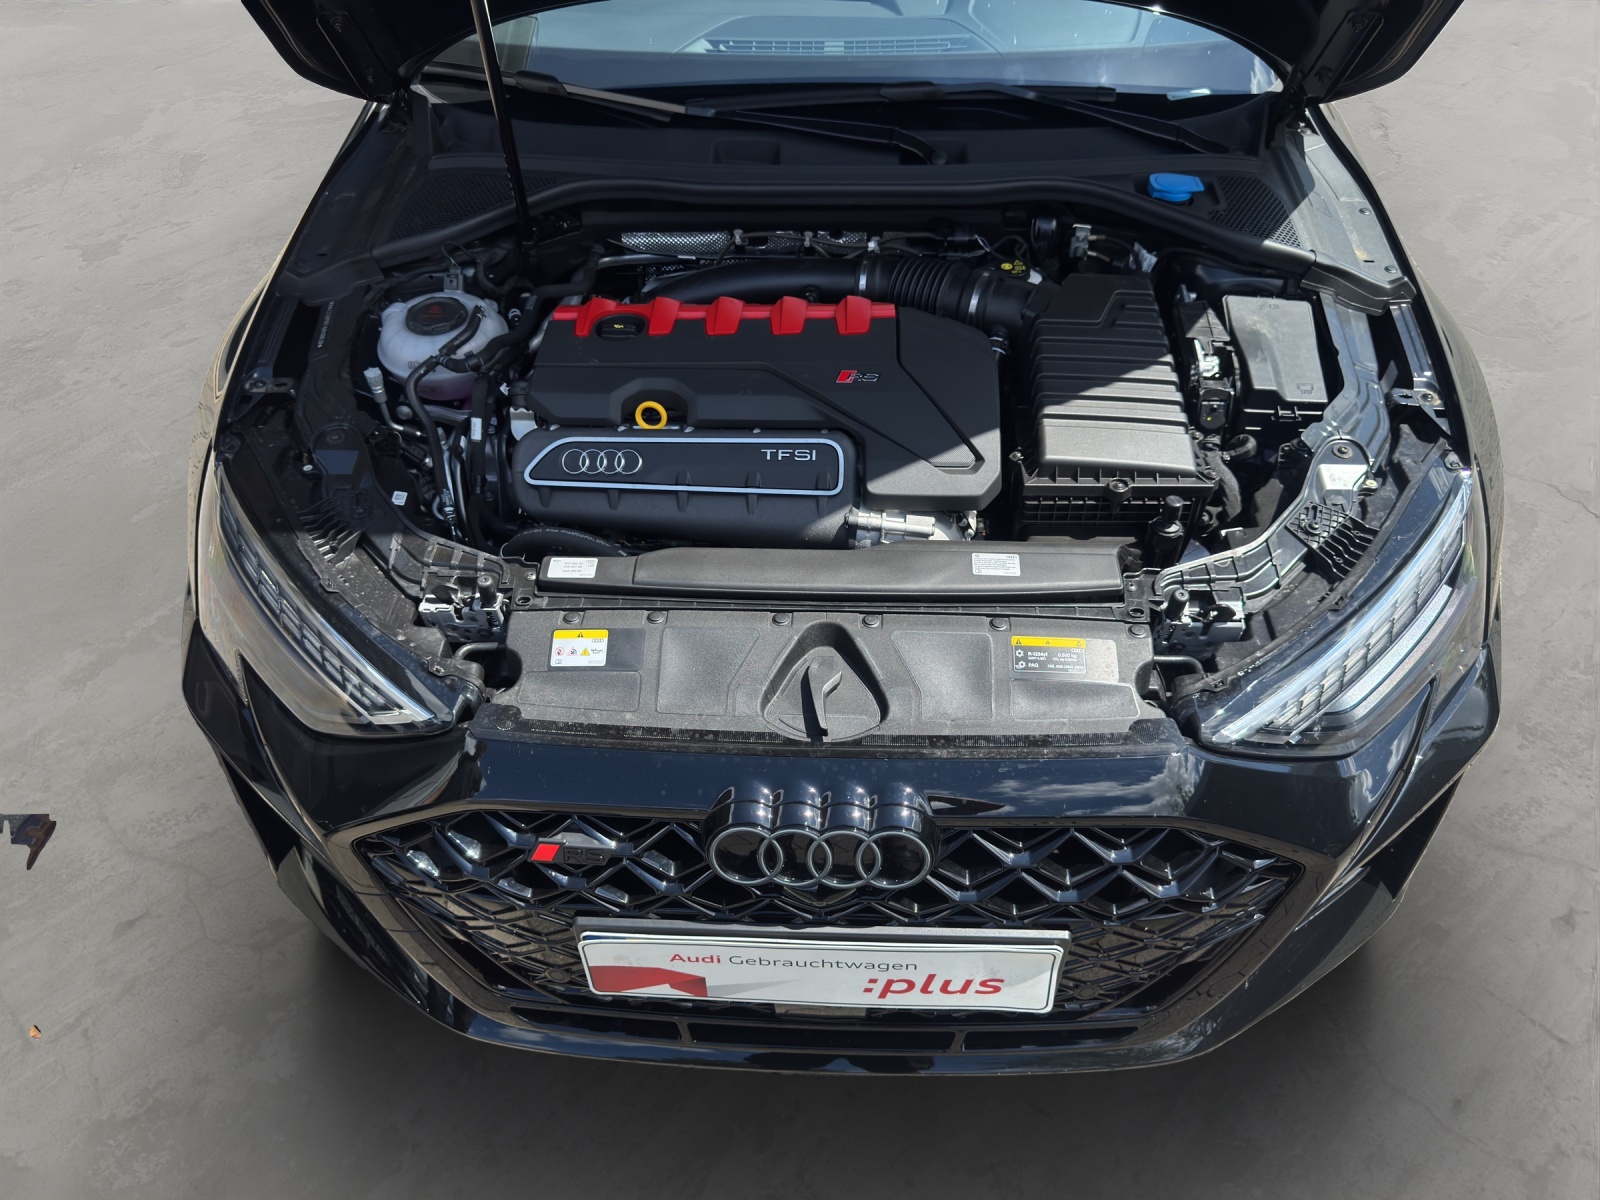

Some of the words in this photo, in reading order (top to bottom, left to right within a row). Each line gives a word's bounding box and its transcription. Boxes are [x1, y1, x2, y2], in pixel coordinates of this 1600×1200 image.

[846, 371, 879, 382] RS
[761, 449, 816, 461] TFSI
[563, 847, 605, 863] RS
[670, 953, 721, 964] Audi
[728, 955, 918, 972] Gebrauchtwagen
